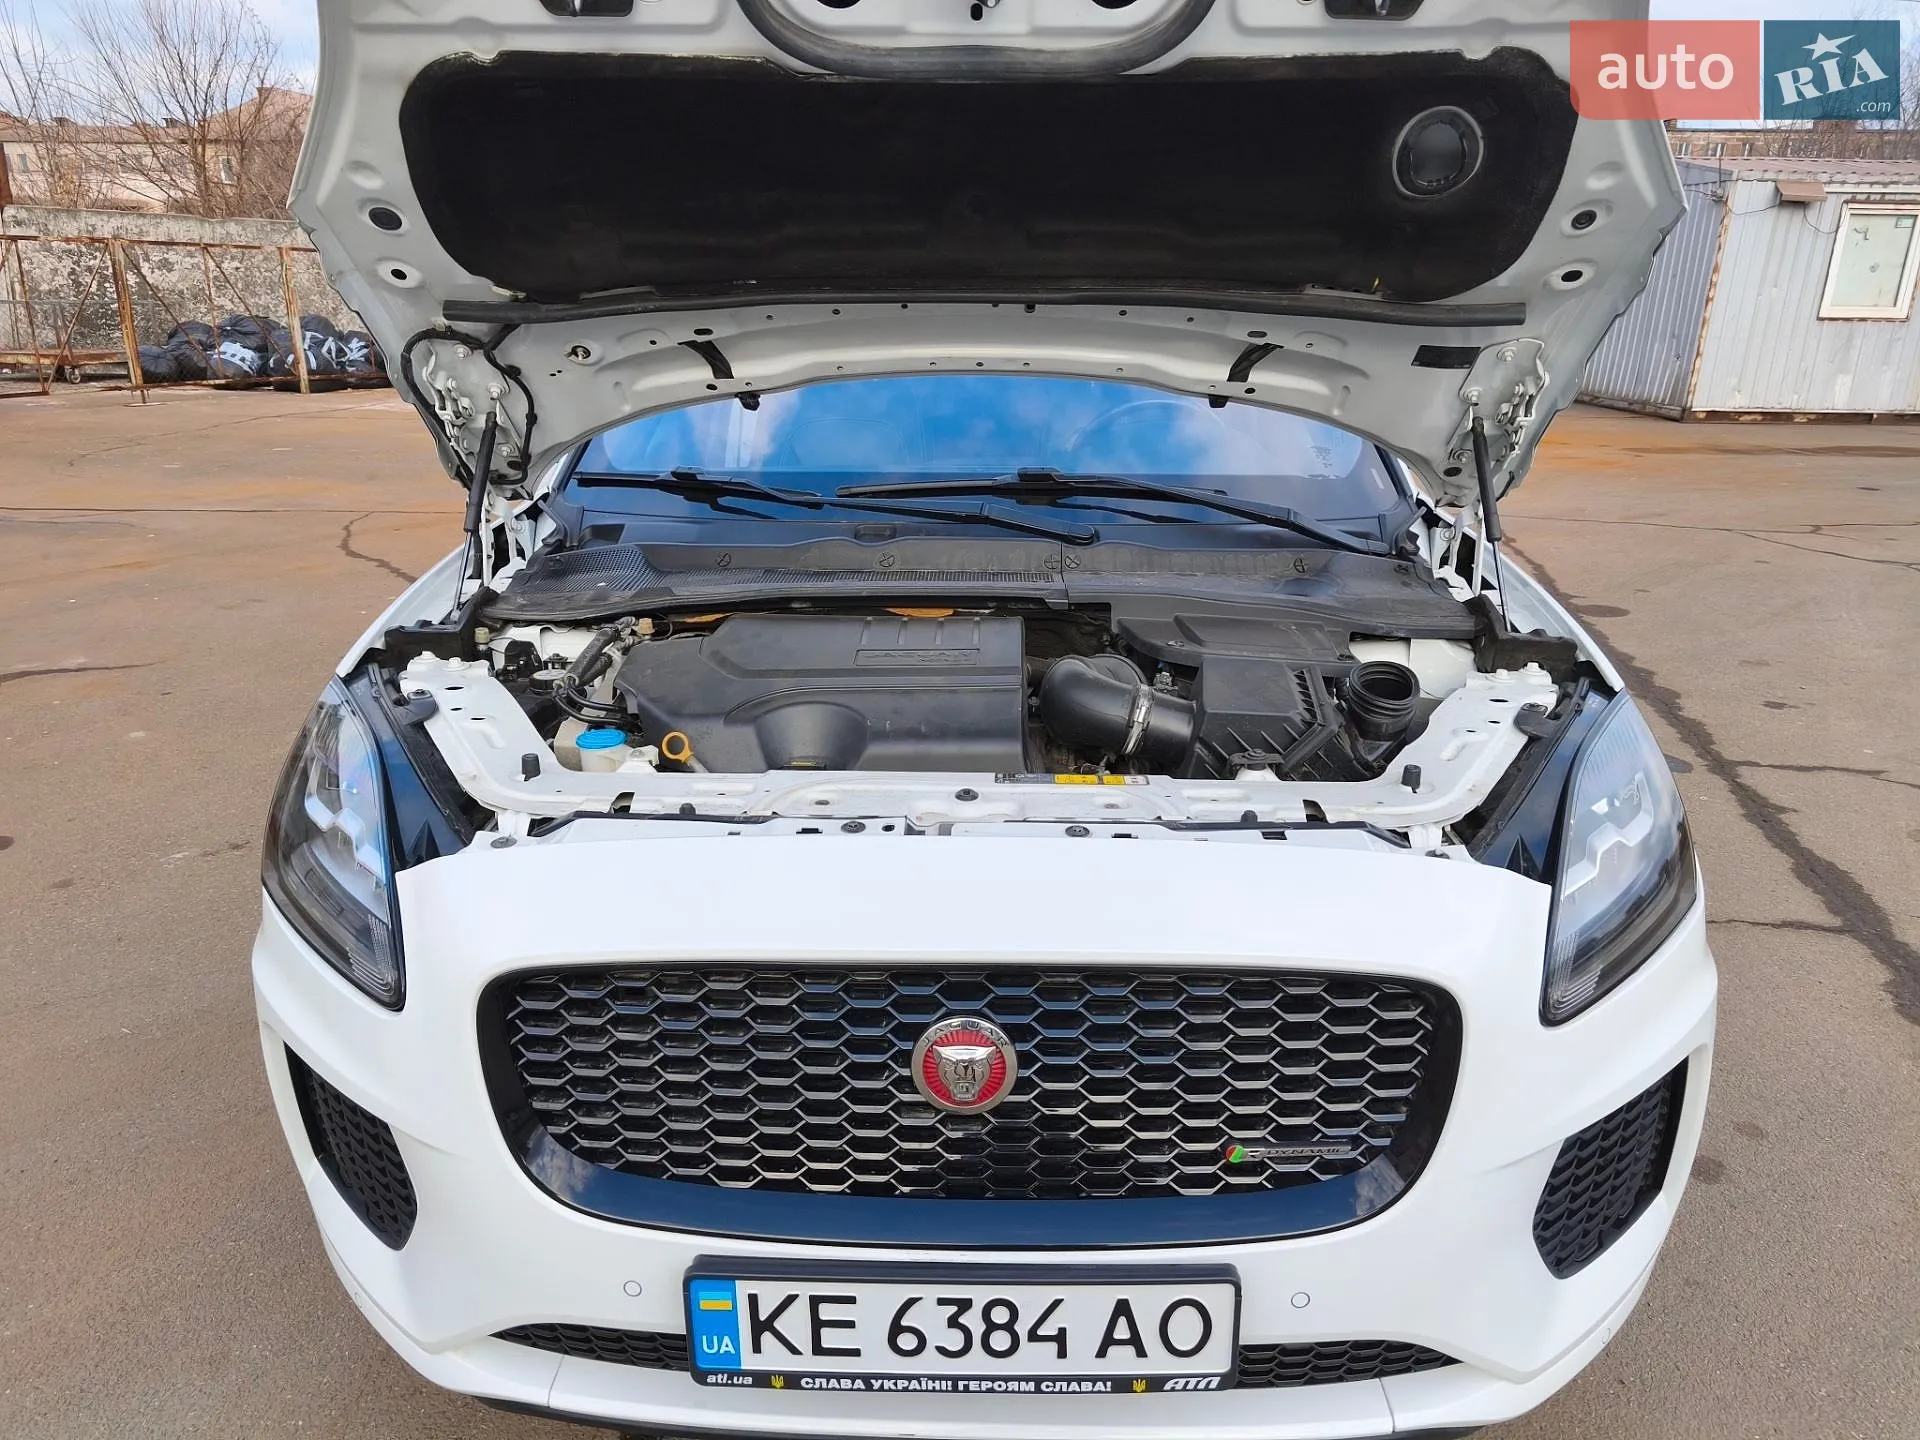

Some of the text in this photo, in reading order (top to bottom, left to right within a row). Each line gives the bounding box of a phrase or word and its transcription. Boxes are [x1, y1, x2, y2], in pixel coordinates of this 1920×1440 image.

[747, 1293, 861, 1357] KE
[887, 1296, 1068, 1359] 6384
[702, 1335, 735, 1355] UA
[800, 1376, 1112, 1392] СЛАВА УКРАЇНІ! ГЕРОЯМ СЛАВА!
